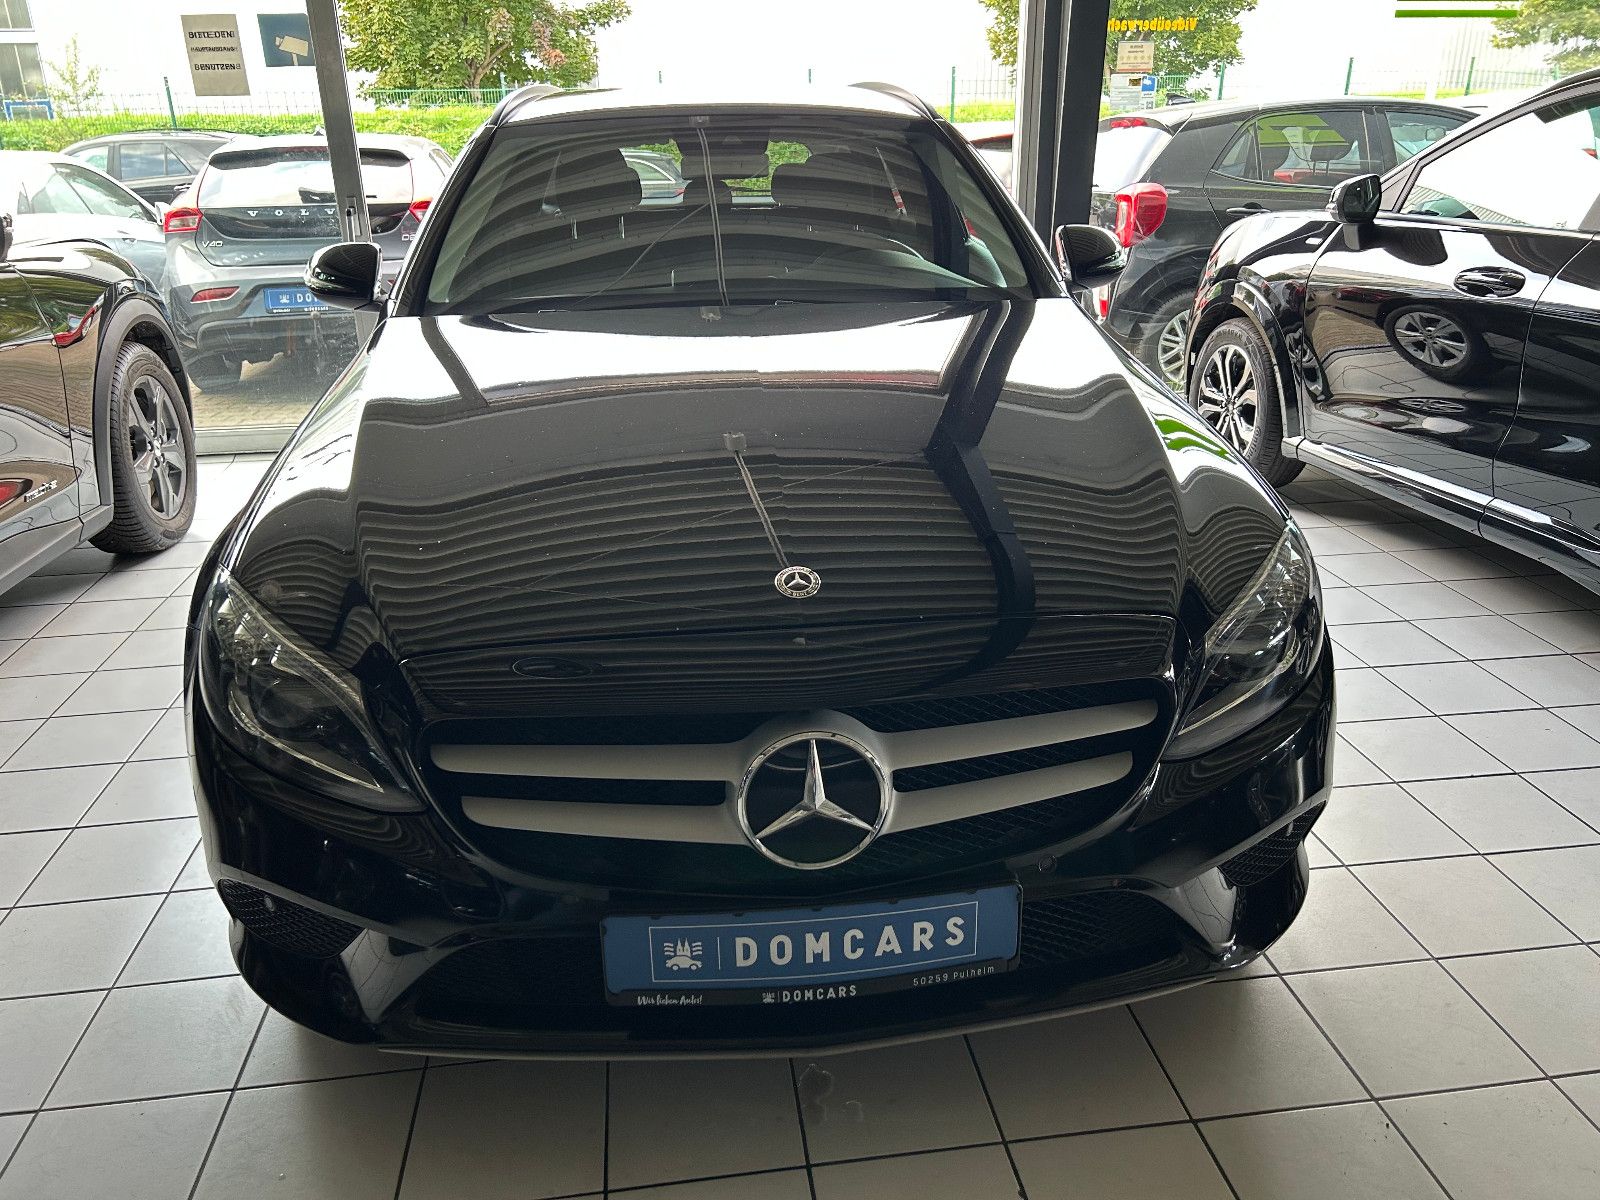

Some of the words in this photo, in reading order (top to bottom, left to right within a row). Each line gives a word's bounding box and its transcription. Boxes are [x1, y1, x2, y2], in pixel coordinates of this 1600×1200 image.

[296, 293, 318, 303] DO
[735, 916, 967, 968] DOMCARS
[913, 973, 949, 986] 50259
[953, 966, 995, 980] Pulheim
[636, 995, 655, 1005] Wir
[679, 994, 703, 1005] Autos!
[781, 984, 857, 1003] DOMCARS
